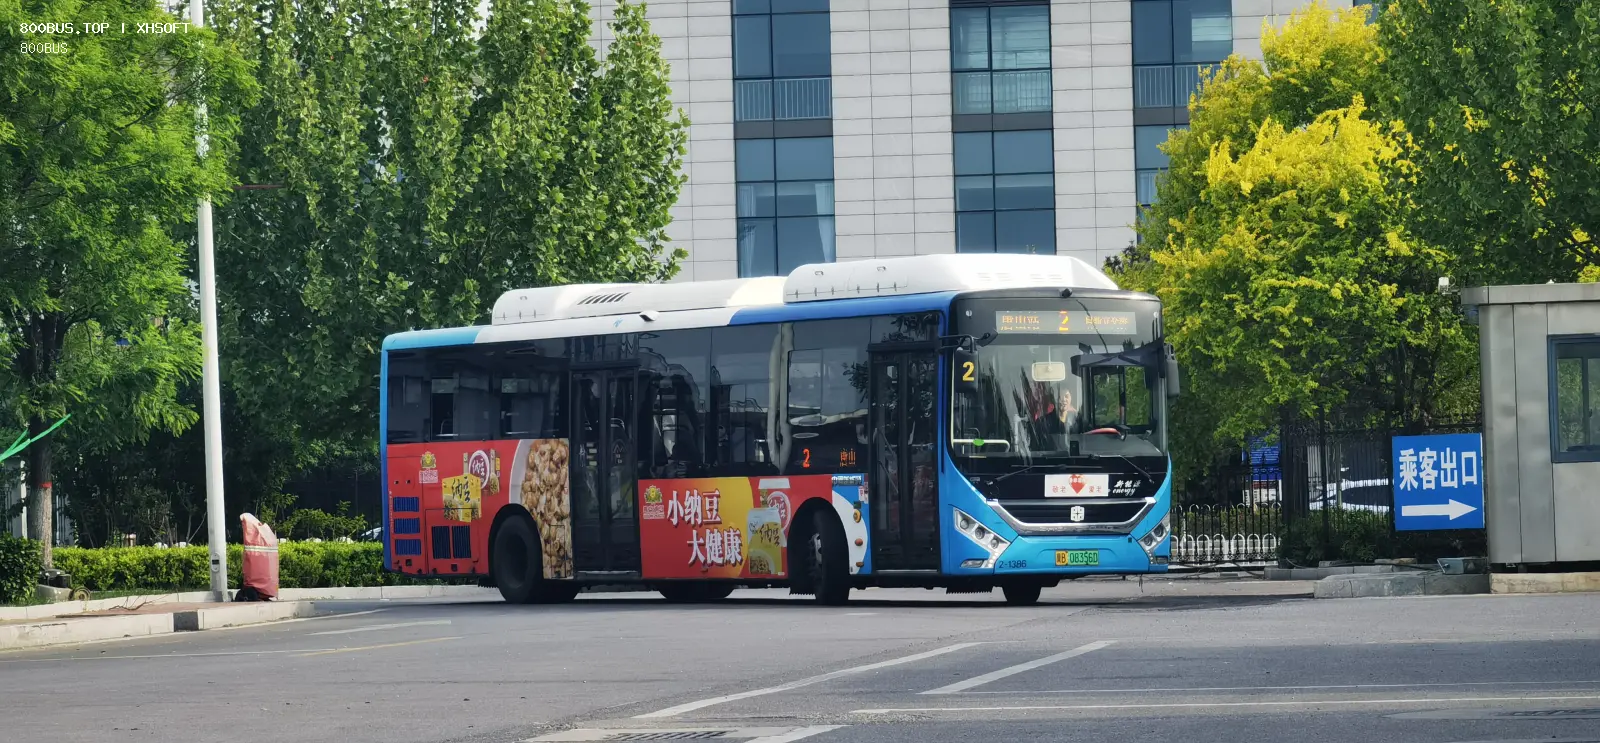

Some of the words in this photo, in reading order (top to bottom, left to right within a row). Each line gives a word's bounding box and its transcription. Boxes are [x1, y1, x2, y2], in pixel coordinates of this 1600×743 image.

[1059, 310, 1069, 331] 2
[962, 361, 975, 382] 2
[803, 448, 811, 468] 2
[1399, 447, 1478, 491] 乘客出口
[1112, 488, 1136, 496] energy
[667, 489, 722, 526] 小纳豆
[687, 527, 744, 566] 大健康
[999, 560, 1027, 568] 2-1386
